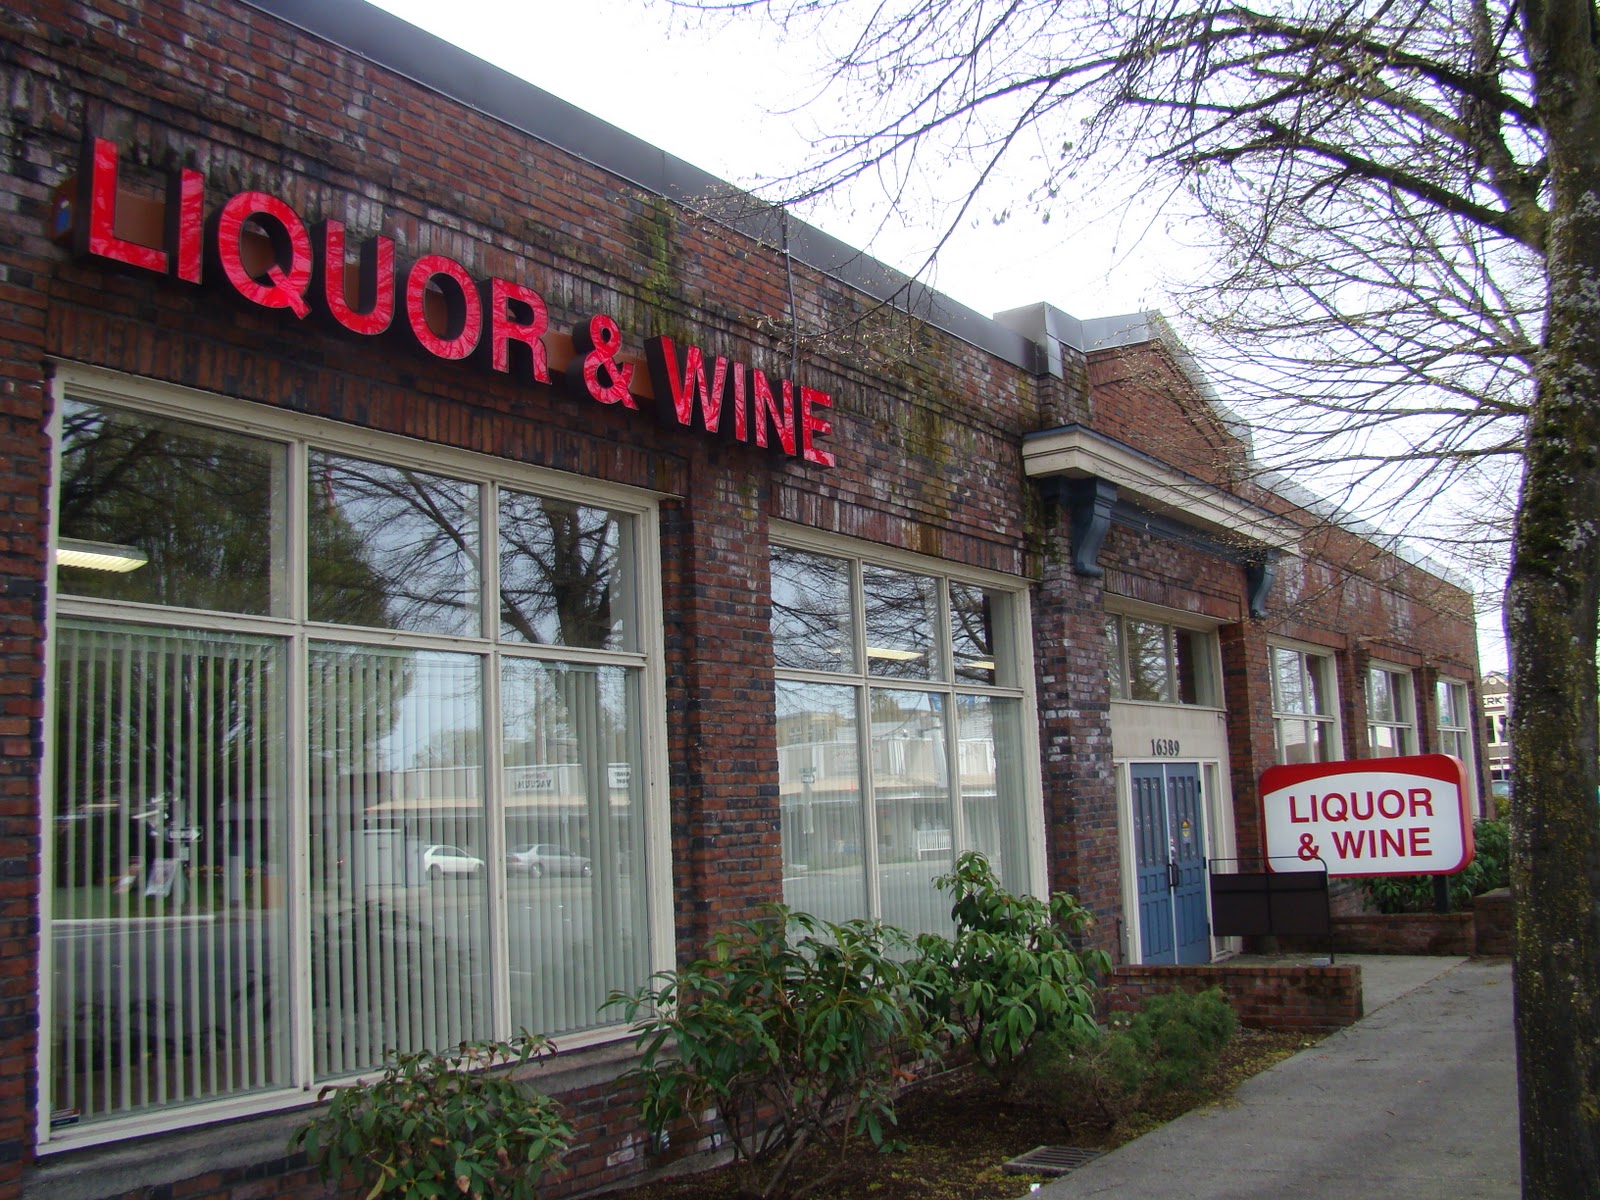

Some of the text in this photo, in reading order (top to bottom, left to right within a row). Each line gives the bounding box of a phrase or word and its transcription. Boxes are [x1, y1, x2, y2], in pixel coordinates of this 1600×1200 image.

[88, 137, 837, 468] LIQUOR & WINE
[1150, 738, 1181, 756] 16389
[1289, 788, 1434, 822] LIQUOR
[1297, 828, 1433, 862] & WINE
